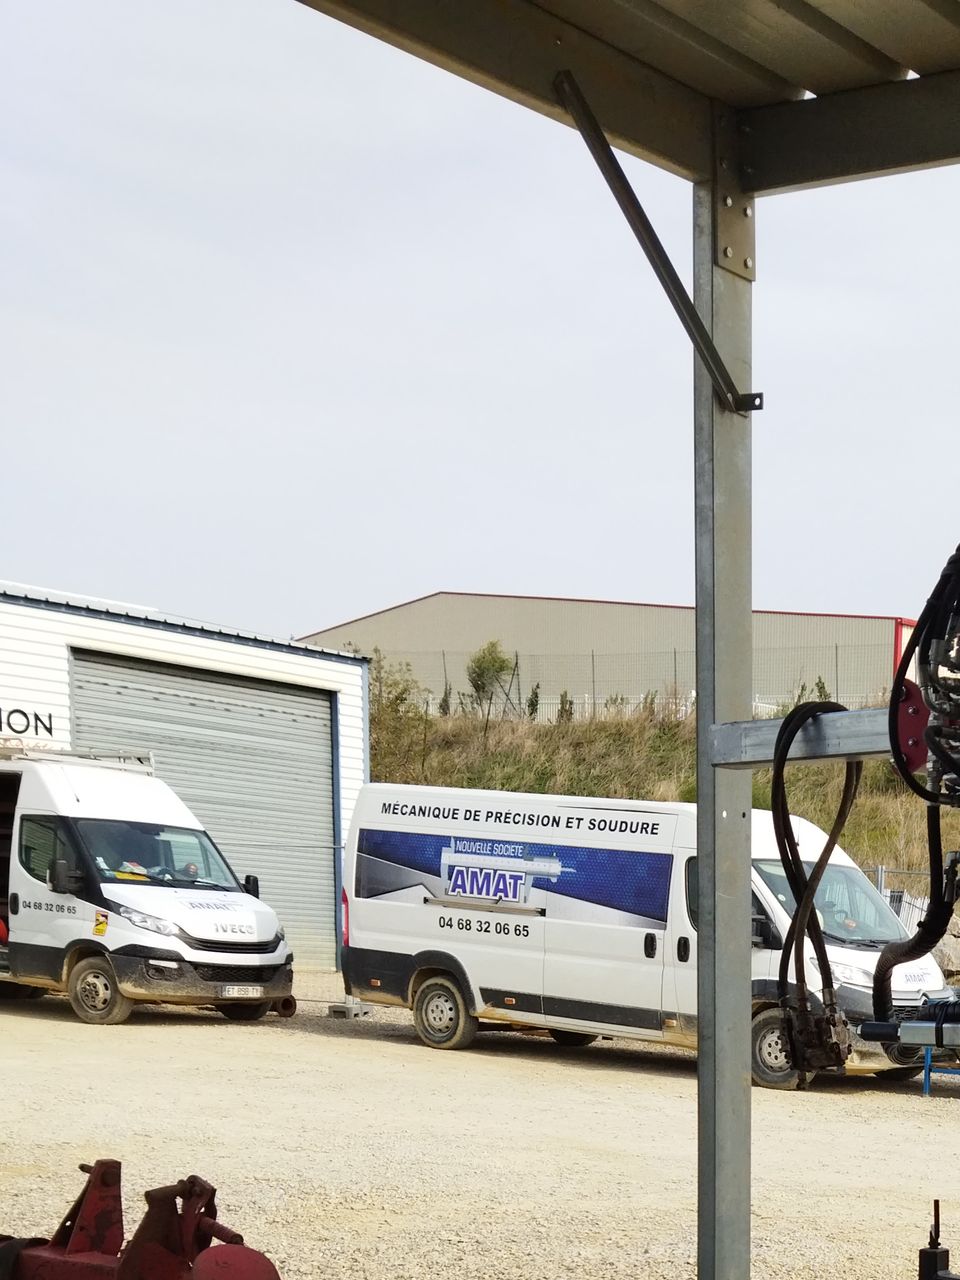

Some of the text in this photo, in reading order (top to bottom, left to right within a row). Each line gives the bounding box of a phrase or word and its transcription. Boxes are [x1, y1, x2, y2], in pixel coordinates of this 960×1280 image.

[381, 800, 660, 836] MÉCANIQUE DE PRÉCISION ET SOUDURE
[455, 840, 492, 854] NOUVELLE
[449, 867, 525, 901] AMAT
[22, 900, 77, 915] 04 68 32 06 65
[213, 922, 256, 935] IVECO
[438, 916, 529, 938] 04 68 32 06 65
